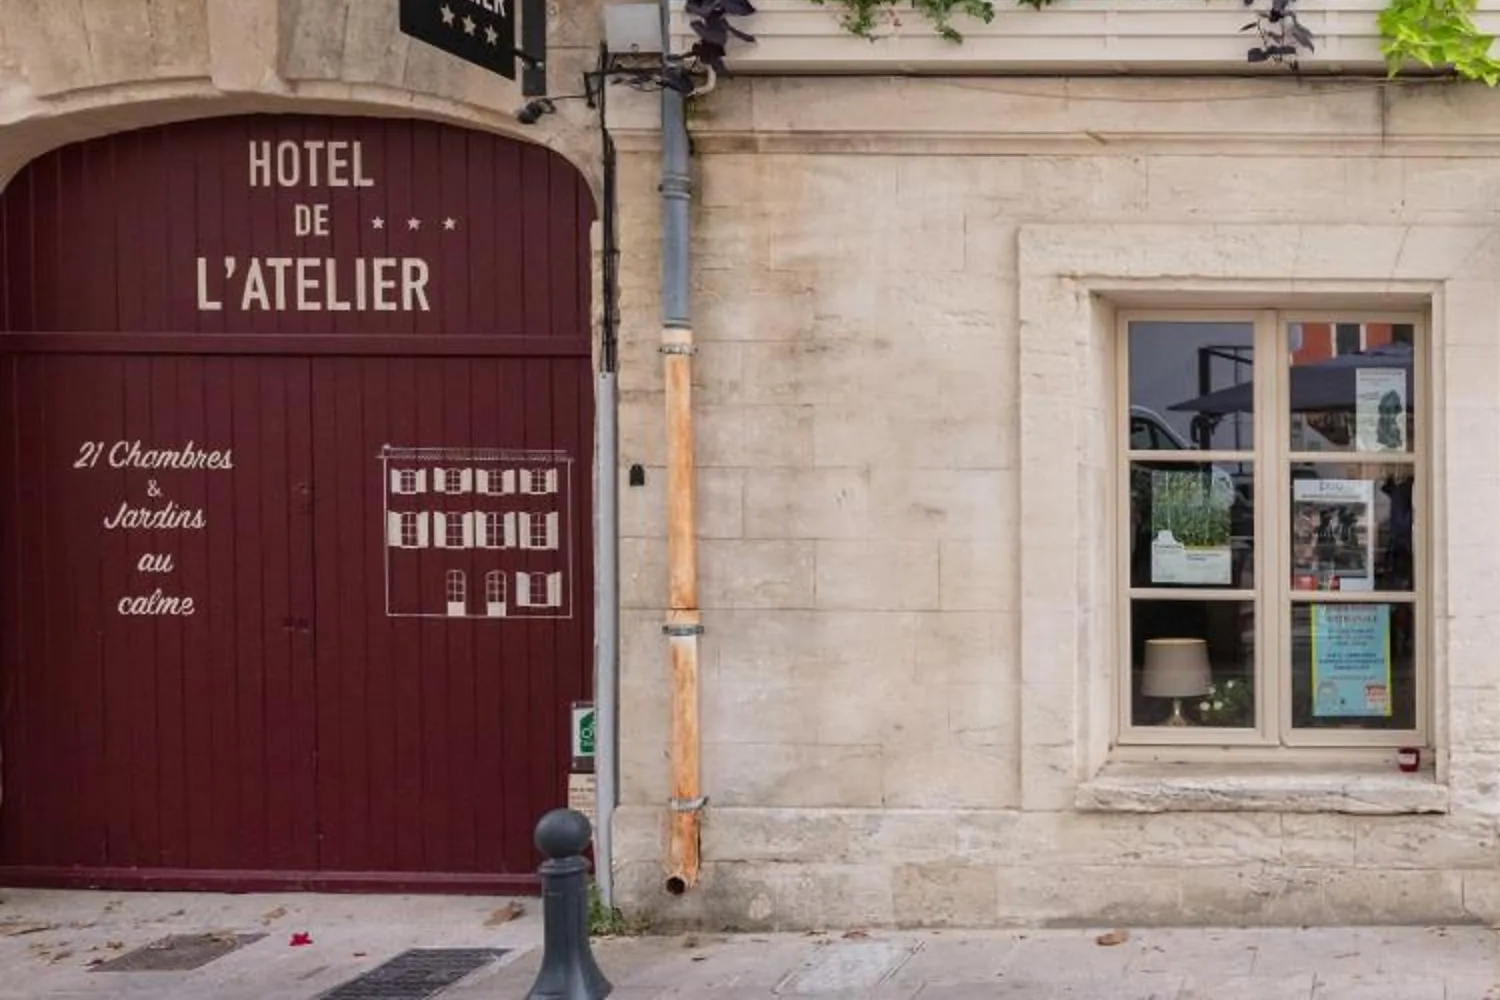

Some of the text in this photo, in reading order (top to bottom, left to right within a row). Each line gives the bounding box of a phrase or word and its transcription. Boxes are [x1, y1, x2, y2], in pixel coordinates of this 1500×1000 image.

[248, 140, 374, 188] HOTEL
[294, 204, 330, 237] DE
[196, 256, 431, 312] L'ATELIER
[73, 440, 235, 471] 21 Chambres
[103, 501, 207, 531] Jardins
[137, 551, 174, 574] au
[118, 588, 195, 618] calme
